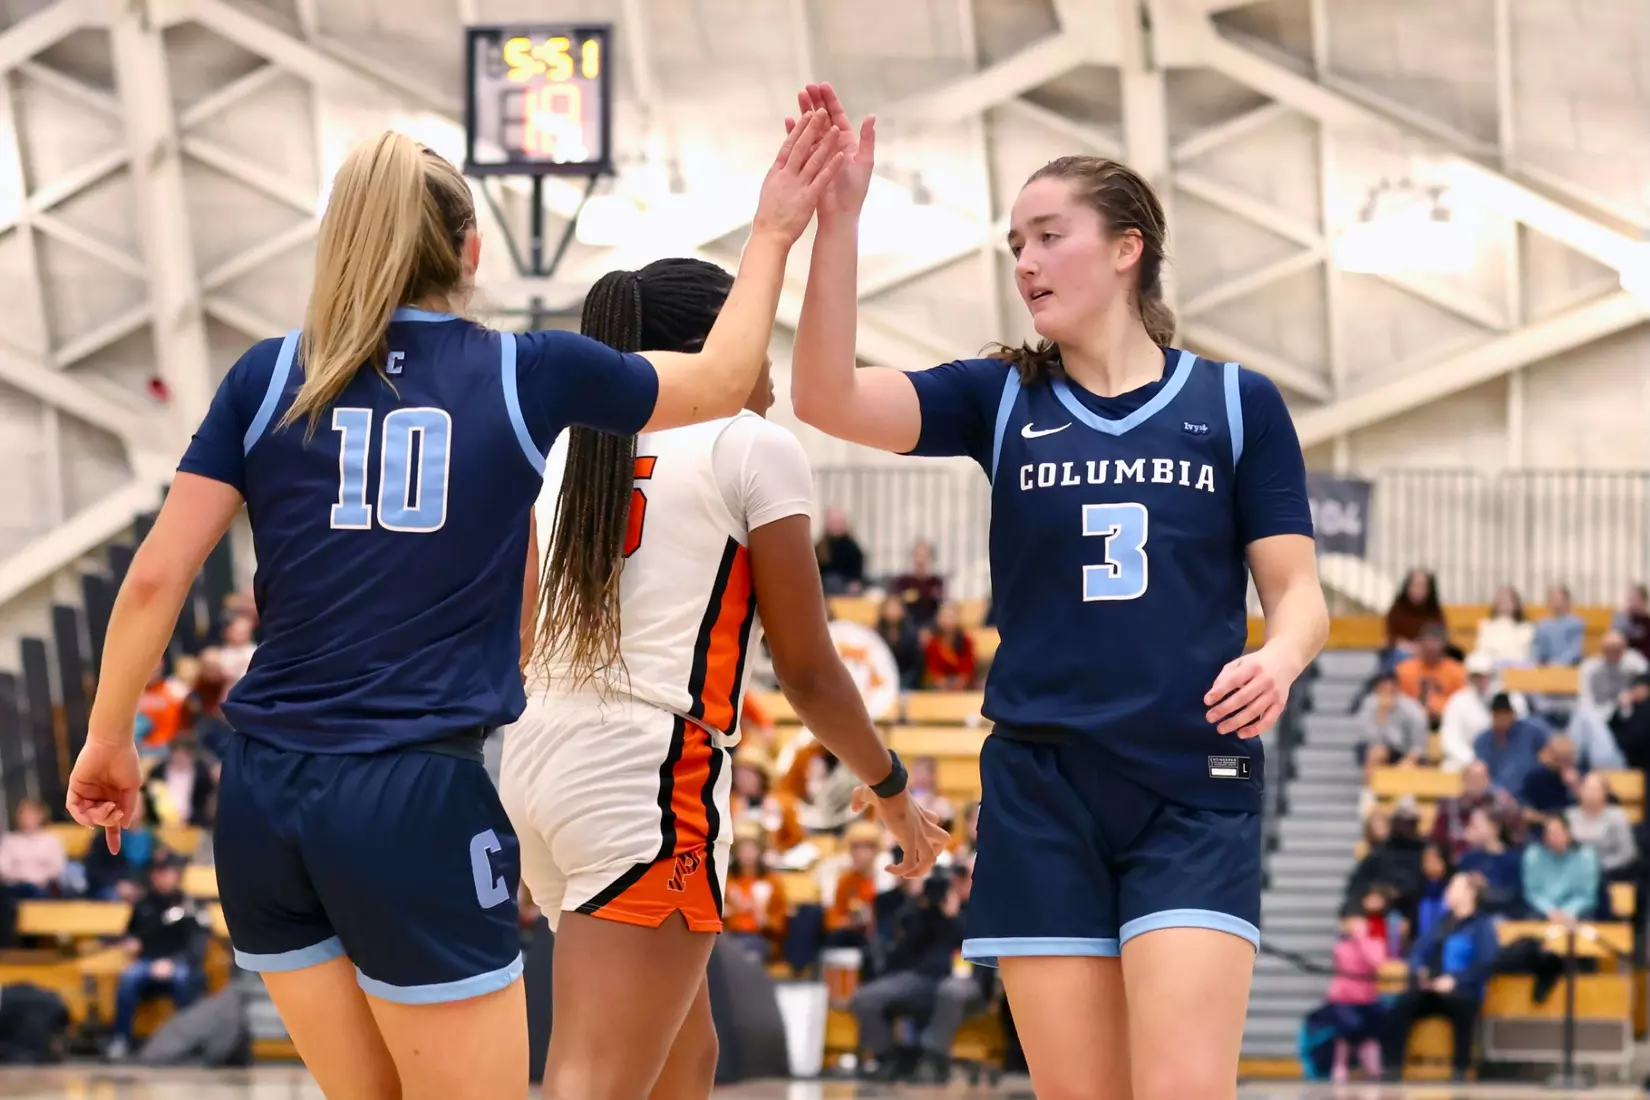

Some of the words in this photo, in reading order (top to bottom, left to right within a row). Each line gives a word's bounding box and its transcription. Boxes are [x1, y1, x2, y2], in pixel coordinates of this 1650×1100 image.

[503, 37, 600, 82] 5:51
[386, 351, 405, 374] C
[330, 407, 452, 533] 10
[1020, 458, 1215, 492] COLUMBIA
[1082, 502, 1148, 602] 3
[1242, 762, 1248, 773] L
[470, 828, 510, 909] C
